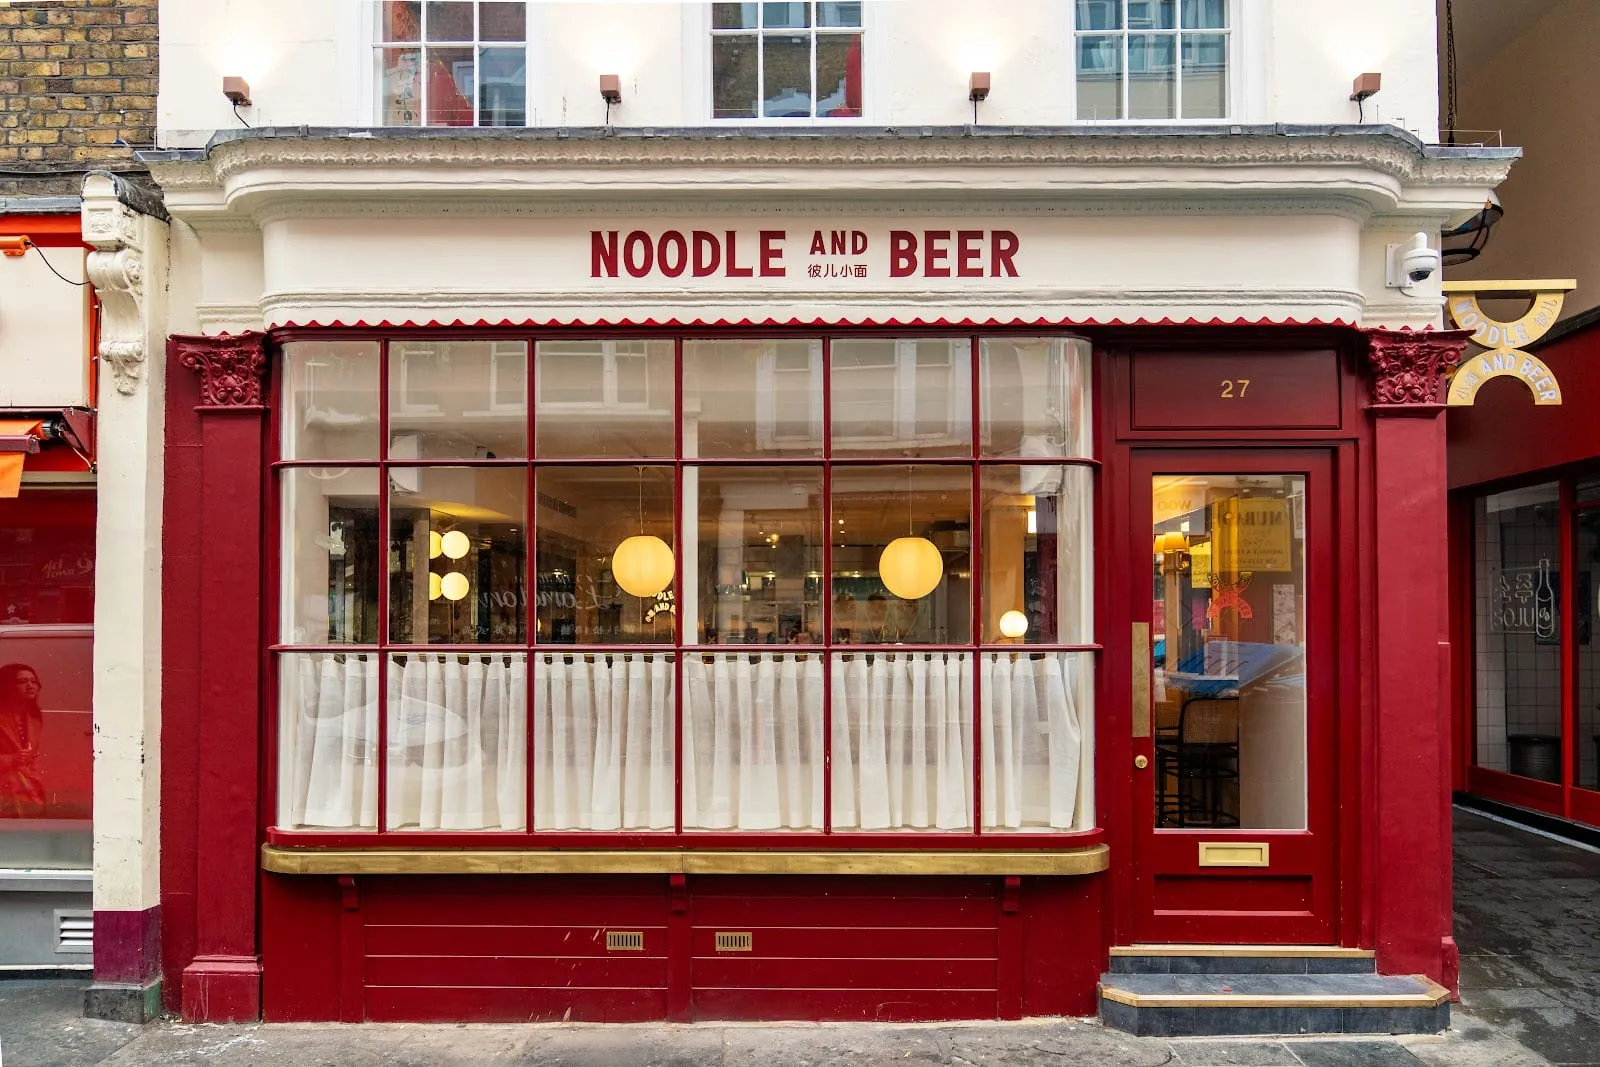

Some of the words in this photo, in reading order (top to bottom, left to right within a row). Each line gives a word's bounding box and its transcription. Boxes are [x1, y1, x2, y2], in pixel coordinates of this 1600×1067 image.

[589, 229, 787, 279] NOODLE
[808, 229, 869, 256] AND
[888, 229, 1021, 279] BEER
[807, 263, 868, 279] 彼儿小面
[1454, 298, 1530, 347] NOODLE
[1220, 379, 1250, 398] 27
[1481, 352, 1517, 376] AND
[1519, 358, 1557, 401] BEER
[1494, 607, 1535, 628] SOJU
